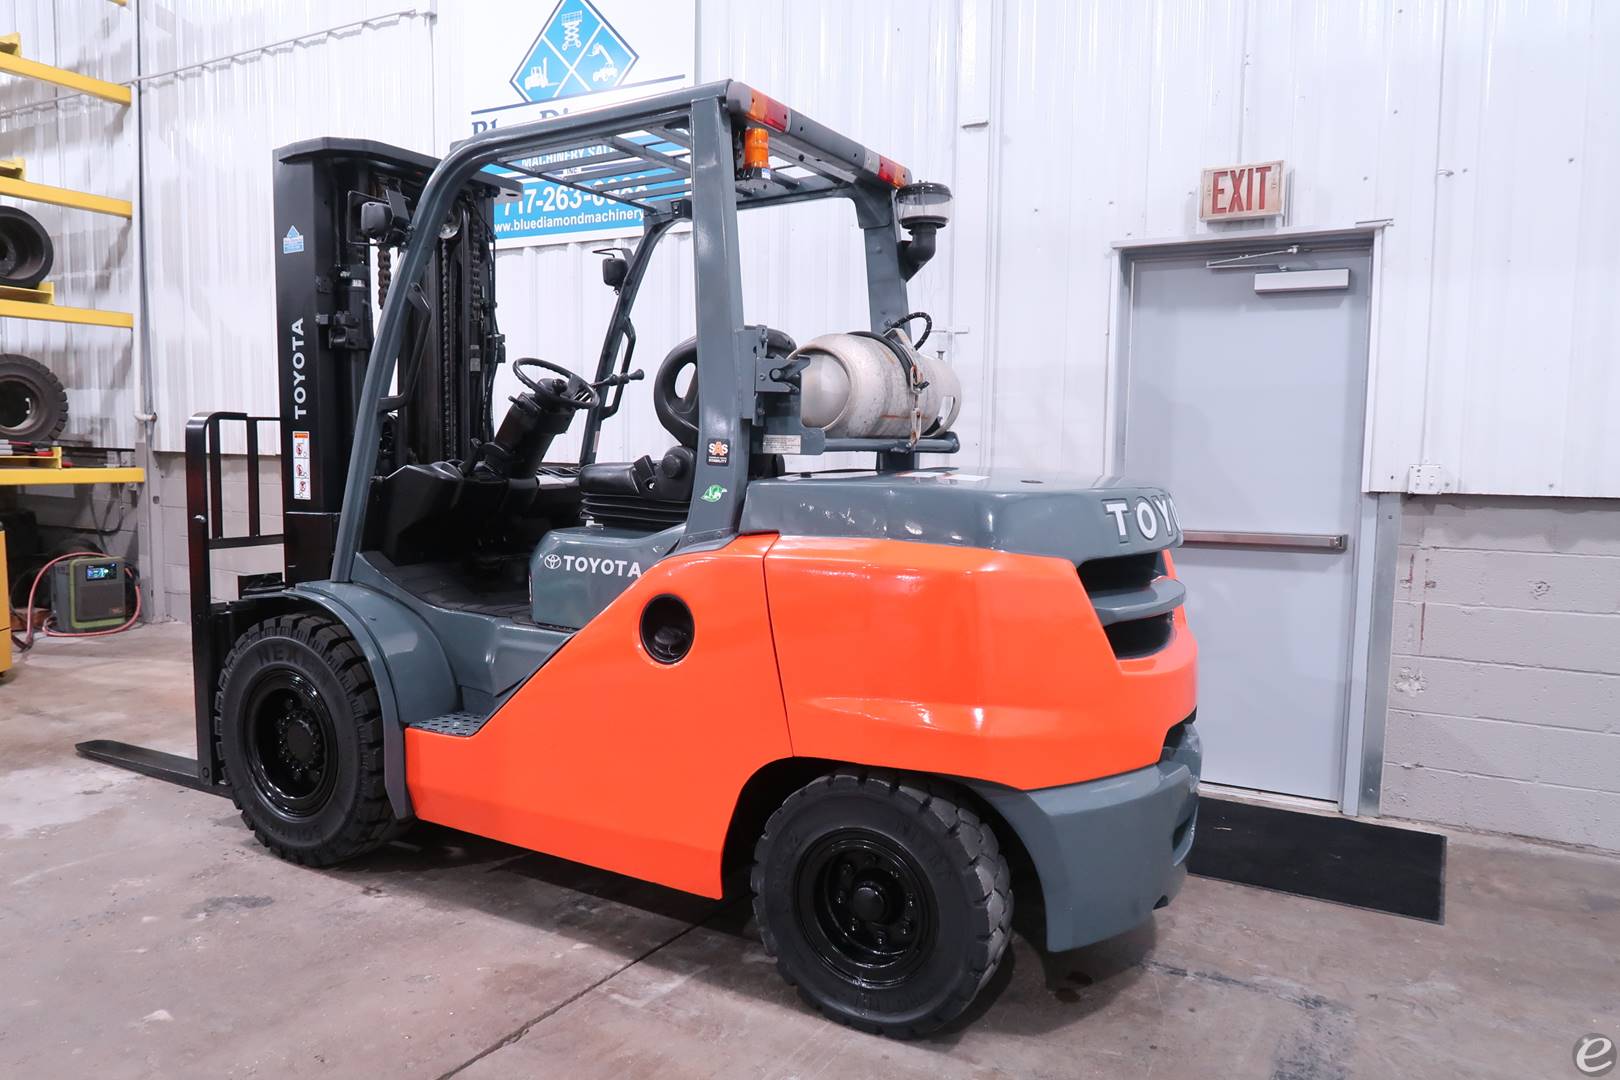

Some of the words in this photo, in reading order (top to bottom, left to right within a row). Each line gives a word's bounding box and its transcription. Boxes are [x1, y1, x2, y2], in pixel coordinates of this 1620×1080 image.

[1212, 166, 1272, 214] EXIT
[291, 317, 307, 420] TOYOTA
[708, 441, 729, 456] SAS
[563, 555, 642, 578] TOYOTA
